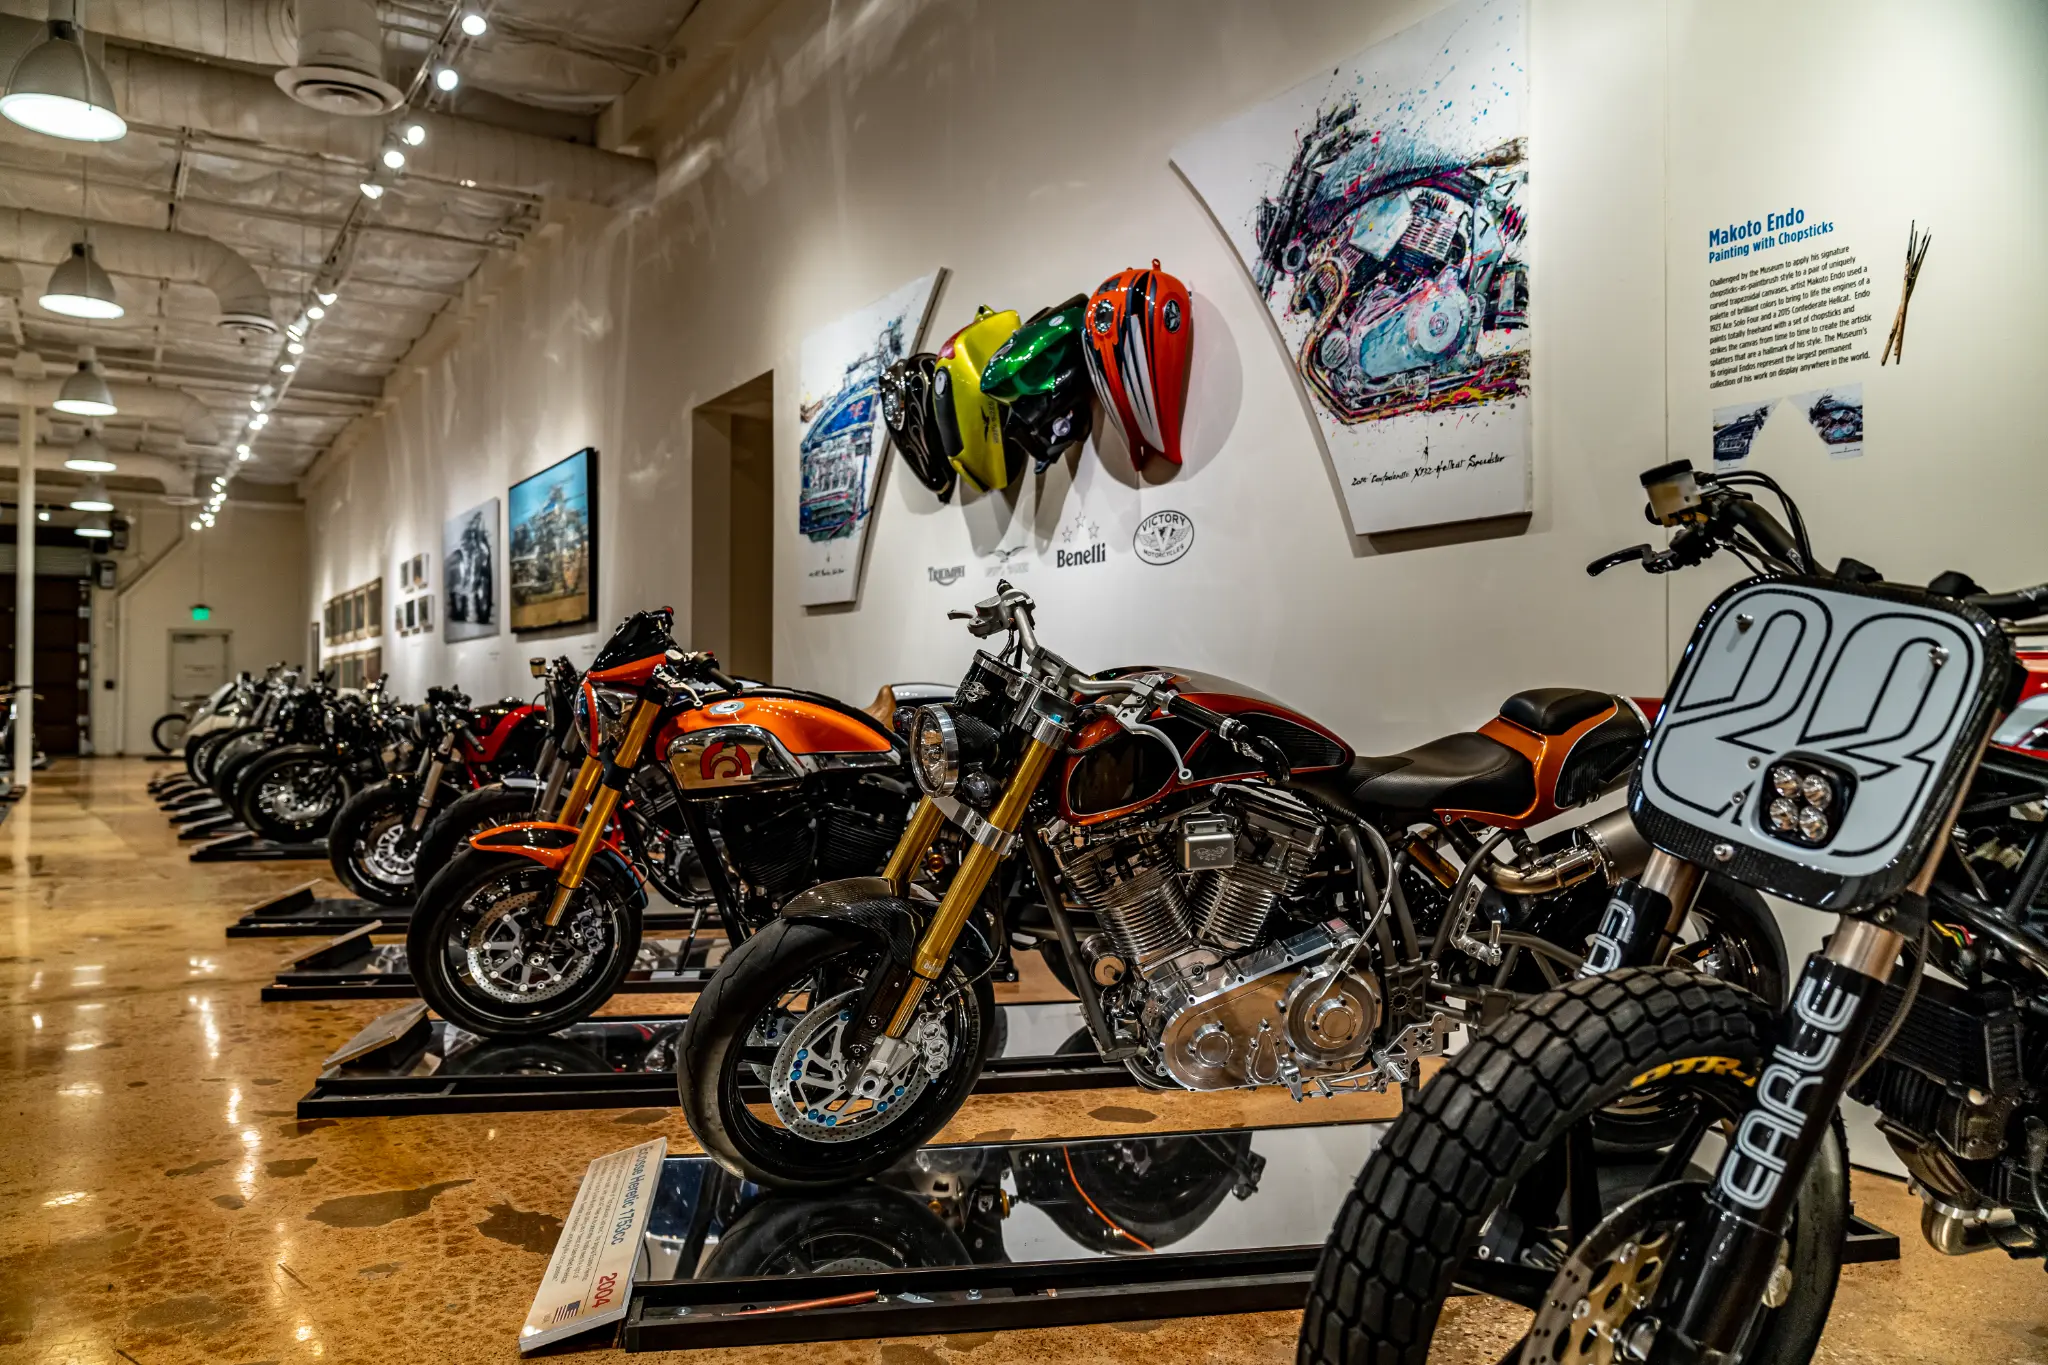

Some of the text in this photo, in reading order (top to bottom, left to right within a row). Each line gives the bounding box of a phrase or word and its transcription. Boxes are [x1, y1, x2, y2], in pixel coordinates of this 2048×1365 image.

[1709, 207, 1804, 248] Makoto Endo
[1709, 221, 1833, 264] Painting with Chopsticks
[1709, 246, 1849, 287] Challenged by the Museum to apply his signature
[1779, 271, 1794, 282] style
[1795, 269, 1802, 277] to
[1807, 264, 1820, 275] pair
[1821, 261, 1828, 271] of
[1828, 256, 1856, 269] uniquely
[1709, 298, 1728, 310] curved
[1729, 290, 1760, 305] trapezoidal
[1790, 279, 1805, 291] artist
[1806, 275, 1829, 287] Makoto
[1830, 270, 1845, 281] Endo
[1846, 265, 1862, 277] used
[1709, 311, 1729, 322] palette
[1730, 308, 1736, 317] of
[1737, 303, 1759, 315] brilliant
[1759, 299, 1777, 310] colors
[1778, 297, 1784, 305] to
[1785, 294, 1801, 304] bring
[1802, 292, 1809, 300] to
[1810, 288, 1820, 298] life
[1820, 286, 1831, 295] the
[1832, 280, 1857, 293] engines
[1857, 277, 1865, 286] of
[1709, 334, 1727, 345] paints
[1727, 329, 1745, 340] totally
[1746, 323, 1772, 336] freehand
[1773, 320, 1787, 330] with
[1792, 316, 1802, 326] set
[1802, 314, 1809, 324] of
[1810, 308, 1841, 322] chopsticks
[1842, 304, 1855, 314] and
[1722, 321, 1732, 330] Ace
[1733, 318, 1746, 328] Solo
[1746, 315, 1759, 324] Four
[1760, 311, 1772, 321] and
[1791, 299, 1827, 314] Confederate
[1854, 289, 1870, 300] Endo
[1709, 313, 1872, 355] strikes the canvas from time to time to create the artistic
[1709, 355, 1734, 367] splatters
[1734, 352, 1746, 362] that
[1746, 351, 1757, 359] are
[1762, 343, 1788, 356] hallmark
[1788, 340, 1796, 350] of
[1796, 339, 1805, 348] his
[1824, 333, 1835, 343] The
[1709, 378, 1736, 389] collection
[1736, 375, 1743, 384] of
[1743, 374, 1752, 383] his
[1753, 371, 1768, 380] work
[1768, 370, 1777, 378] on
[1777, 365, 1799, 376] display
[1799, 360, 1830, 372] anywhere
[1830, 357, 1837, 366] in
[1838, 356, 1849, 364] the
[1716, 365, 1738, 376] original
[1738, 362, 1756, 372] Endos
[1756, 355, 1784, 368] represent
[1785, 354, 1796, 363] the
[1796, 349, 1817, 360] largest
[1817, 342, 1852, 357] permanent
[1142, 513, 1186, 532] VICTORY
[1056, 543, 1106, 568] Benelli
[1143, 543, 1184, 558] MOTORCYCLES
[928, 565, 966, 585] TRIUMPH
[1720, 977, 1861, 1210] EARLE
[610, 1145, 654, 1245] Ecosse Heretic 1753cc
[591, 1271, 618, 1309] 2004
